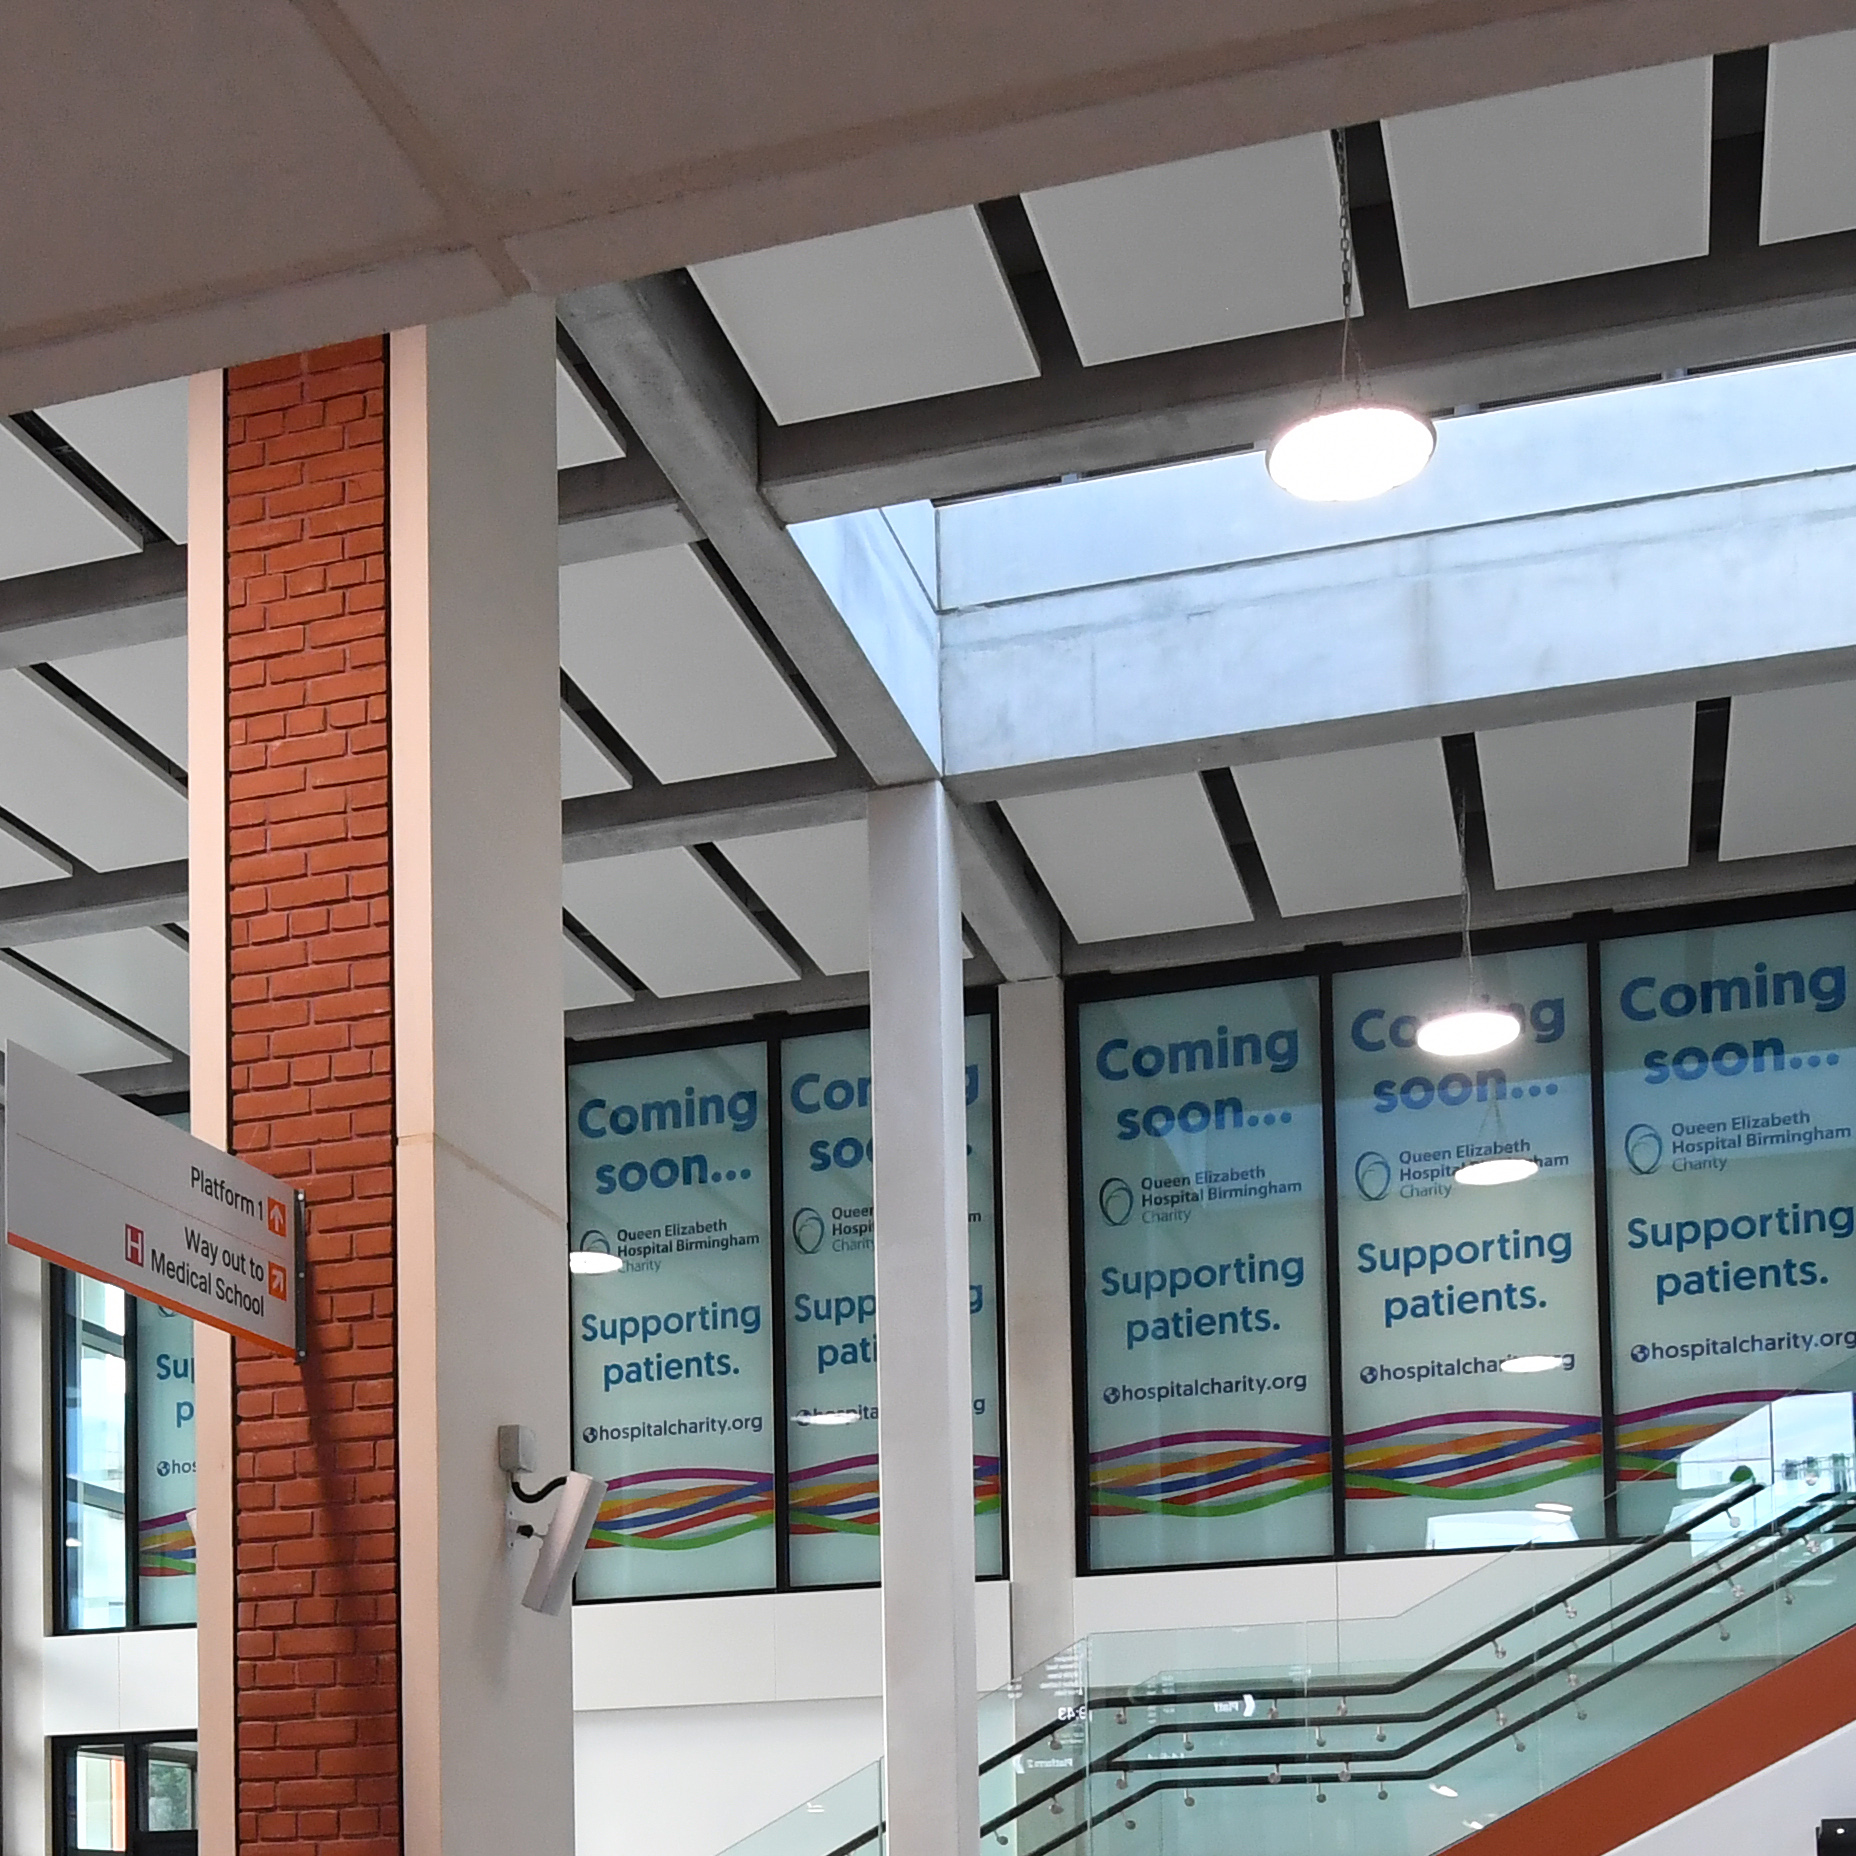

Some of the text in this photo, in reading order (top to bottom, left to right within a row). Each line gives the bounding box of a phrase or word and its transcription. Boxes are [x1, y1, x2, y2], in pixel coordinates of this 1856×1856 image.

[1620, 961, 1846, 1022] Coming
[1096, 1025, 1299, 1081] Coming
[1644, 1037, 1840, 1085] soon...
[577, 1086, 758, 1139] Coming
[1373, 1068, 1559, 1114] soon...
[1117, 1096, 1293, 1141] soon...
[1671, 1109, 1811, 1138] Queen Elizabeth
[1672, 1125, 1852, 1155] Hospital Birmingham
[1399, 1139, 1531, 1165] Queen Elizabeth
[1672, 1156, 1728, 1173] Charity
[190, 1165, 263, 1221] Platform 1
[596, 1154, 752, 1195] soon...
[1141, 1165, 1266, 1191] Queen Elizabeth
[1142, 1180, 1302, 1208] Hospital Birmingham
[1399, 1183, 1453, 1199] Charity
[617, 1219, 728, 1243] Queen Elizabeth
[1142, 1207, 1192, 1224] Charity
[1628, 1202, 1855, 1252] Supporting
[184, 1226, 265, 1283] Way out to
[618, 1233, 760, 1259] Hospital Birmingham
[1357, 1229, 1572, 1277] Supporting
[151, 1248, 212, 1296] Medical
[215, 1277, 265, 1318] School
[1101, 1252, 1304, 1300] Supporting
[1656, 1258, 1829, 1306] patients.
[581, 1301, 761, 1346] Supporting
[1384, 1283, 1547, 1328] patients.
[1126, 1306, 1281, 1350] patients.
[604, 1351, 740, 1392] patients.
[1122, 1374, 1307, 1402] hospitalcharity.org
[599, 1415, 763, 1443] hospitalcharity.org
